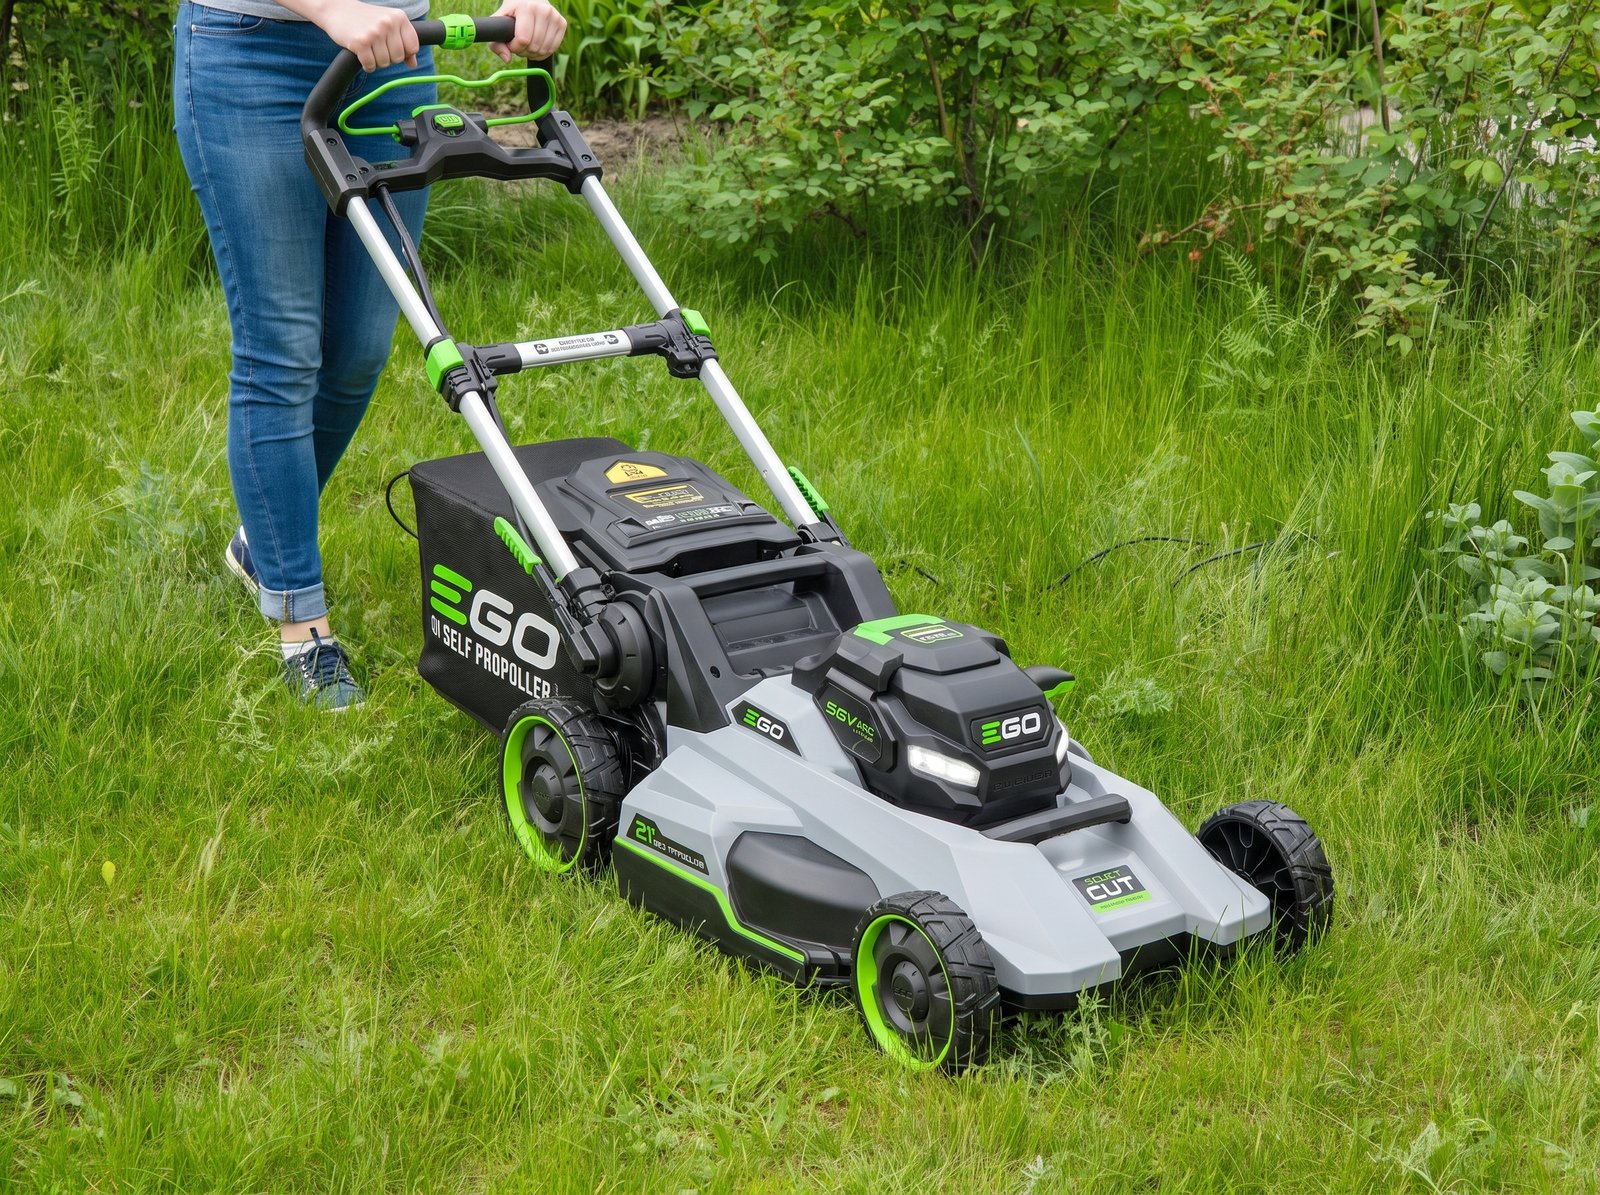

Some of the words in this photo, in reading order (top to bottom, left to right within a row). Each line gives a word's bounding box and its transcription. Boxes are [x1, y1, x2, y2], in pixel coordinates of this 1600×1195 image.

[430, 563, 561, 670] EGO
[443, 624, 473, 659] SELF
[475, 642, 551, 699] PROPOLLER
[743, 708, 785, 740] EGO
[981, 712, 1041, 745] EGO
[1086, 875, 1134, 901] CUT
